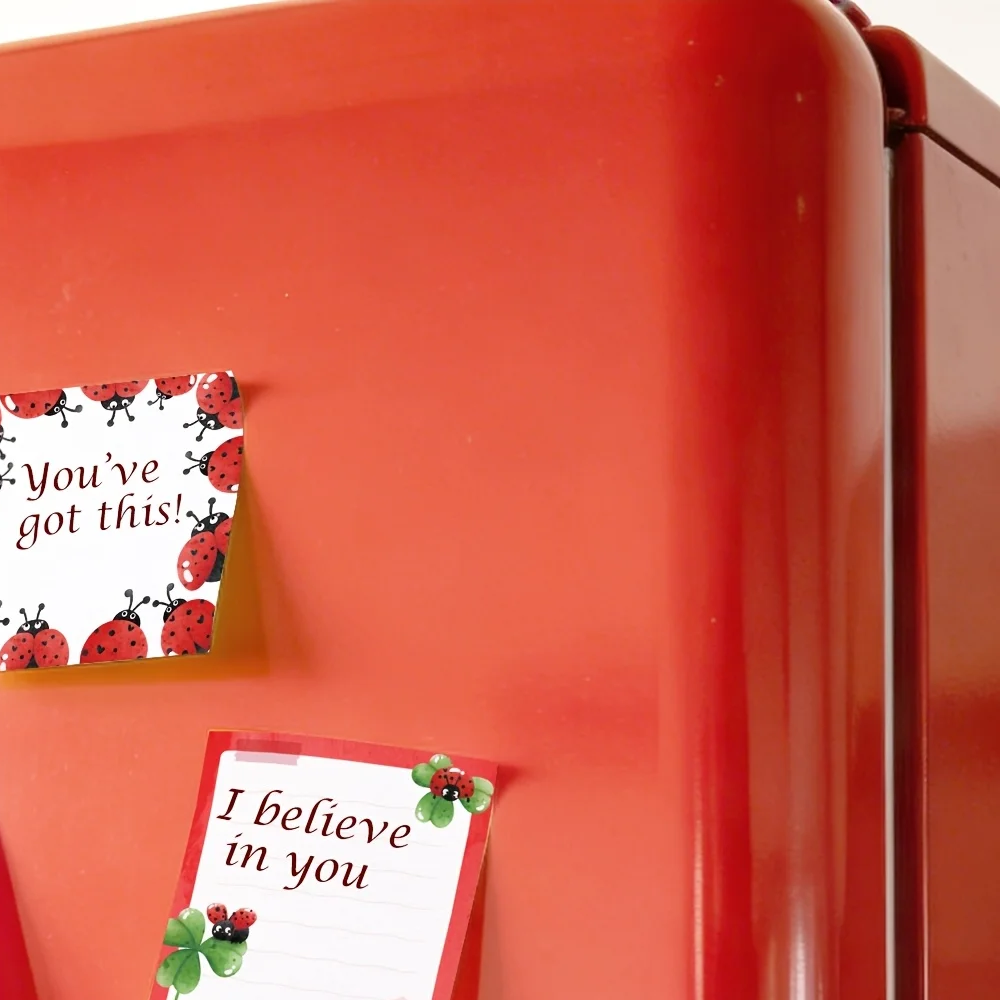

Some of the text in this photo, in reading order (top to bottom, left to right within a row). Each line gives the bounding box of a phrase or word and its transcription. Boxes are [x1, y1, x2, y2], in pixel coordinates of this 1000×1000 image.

[19, 451, 161, 502] You’ve
[16, 493, 184, 551] got this!
[216, 787, 412, 849] I believe
[225, 832, 370, 891] in you
